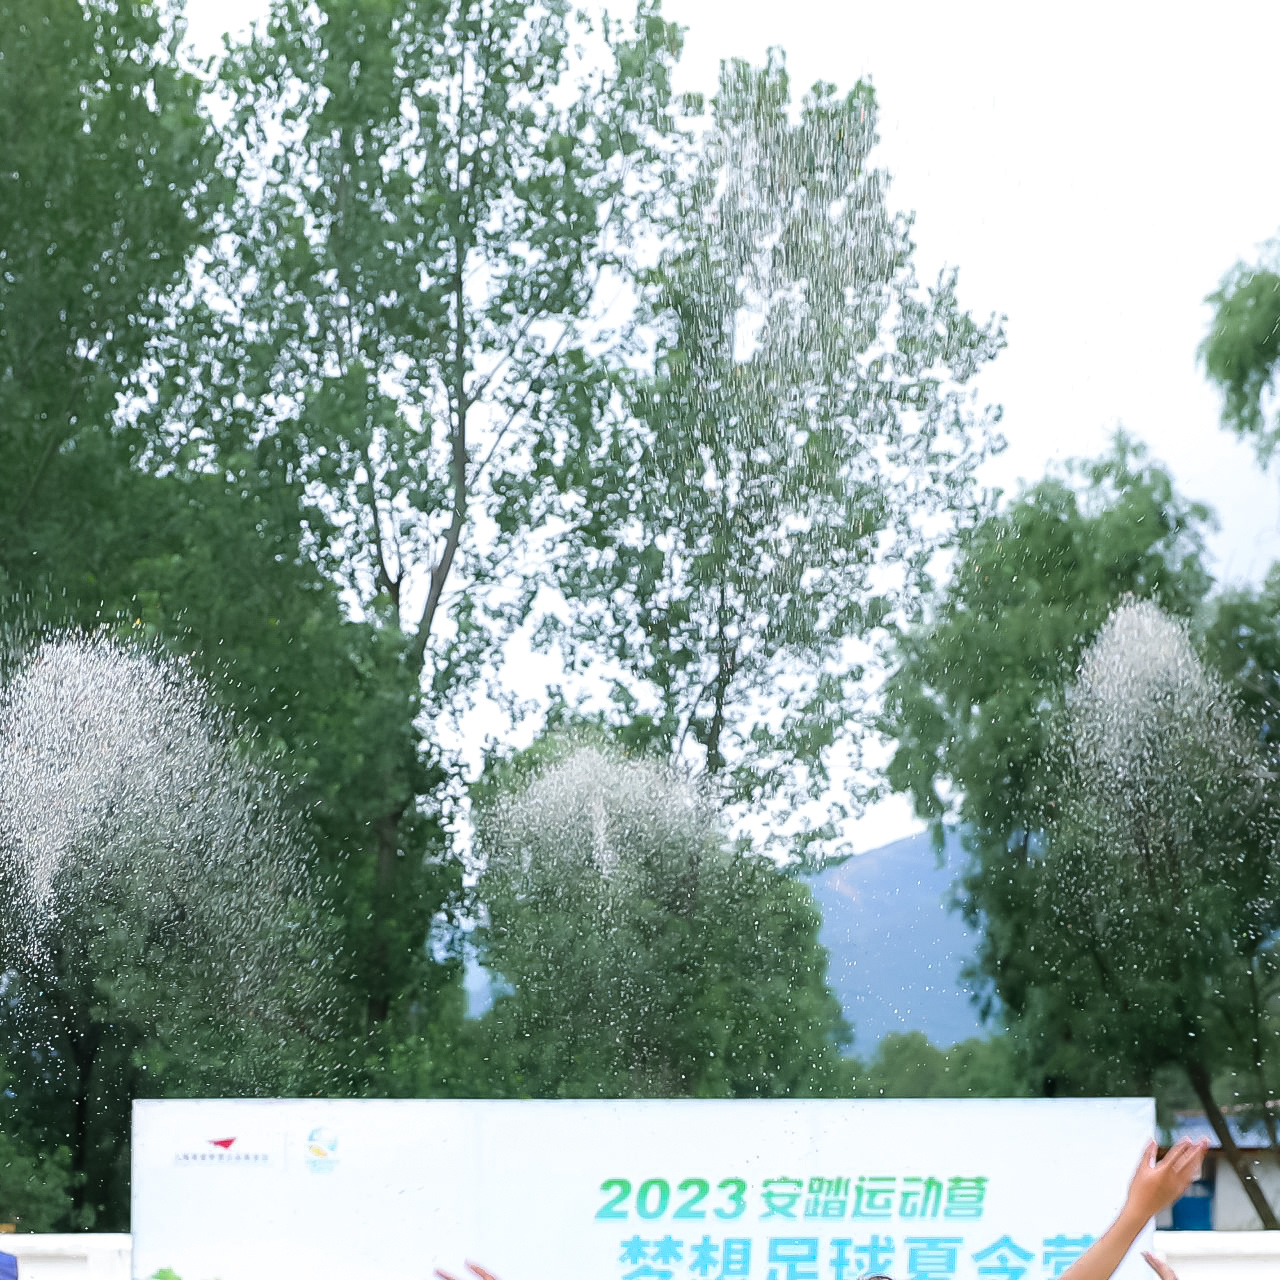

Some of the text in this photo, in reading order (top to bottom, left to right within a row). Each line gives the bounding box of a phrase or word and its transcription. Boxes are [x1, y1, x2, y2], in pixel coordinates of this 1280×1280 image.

[595, 1176, 989, 1219] 2023 安踏运动营
